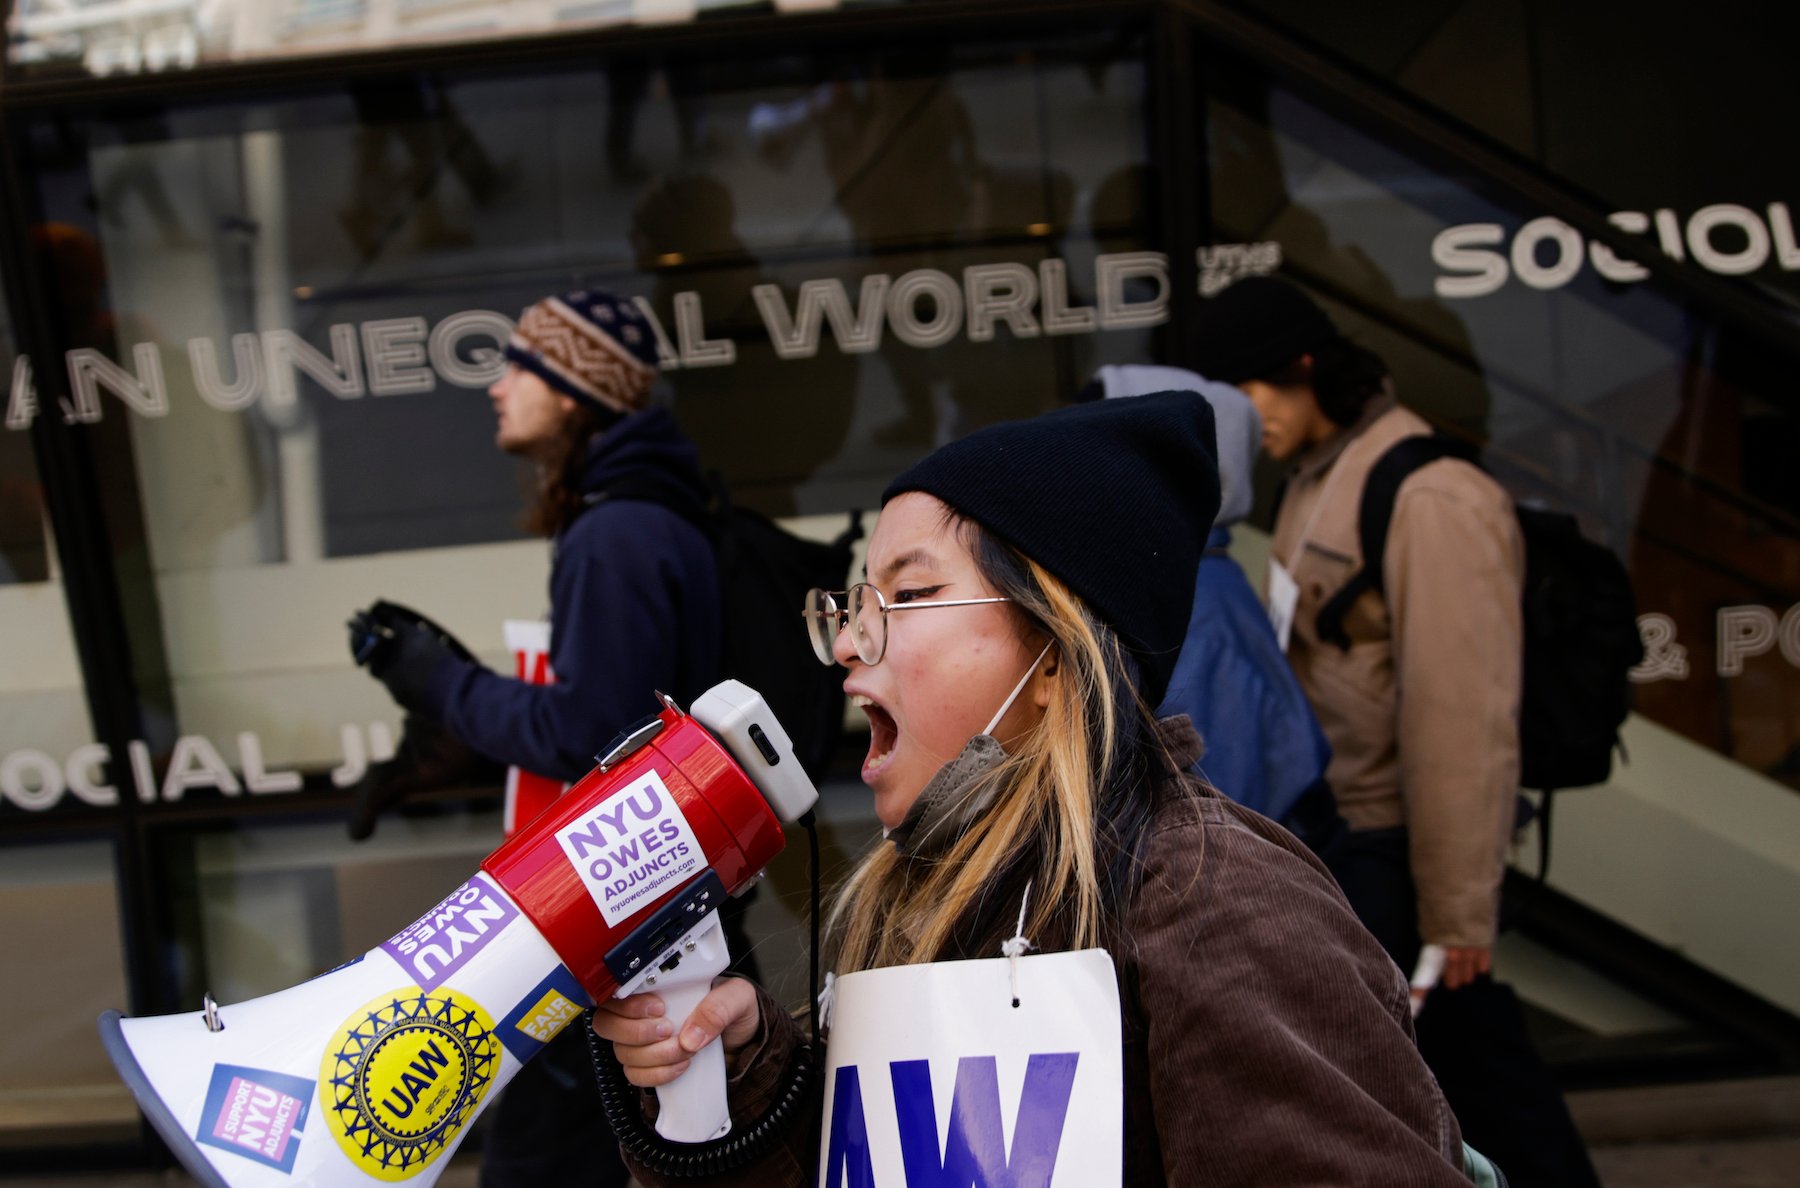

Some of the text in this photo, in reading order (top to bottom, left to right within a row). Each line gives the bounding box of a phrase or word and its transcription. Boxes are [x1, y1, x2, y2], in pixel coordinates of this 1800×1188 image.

[752, 250, 1171, 360] WORLD
[1626, 612, 1690, 683] &
[567, 784, 663, 860] NYU
[589, 818, 680, 882] OWES
[604, 841, 690, 902] ADJUNCTS
[609, 856, 696, 914] nyuowesadjuncts.com
[390, 881, 471, 947] ADJUNCTS
[397, 886, 480, 956] OWES
[413, 894, 506, 981] NYU
[524, 997, 569, 1036] FAIR
[537, 1004, 578, 1044] PAY!
[225, 1079, 253, 1134] SUPPORT
[381, 1038, 451, 1120] UAW
[237, 1085, 278, 1150] NYU
[261, 1095, 294, 1157] ADJUNCTS
[826, 1051, 1080, 1188] AW
